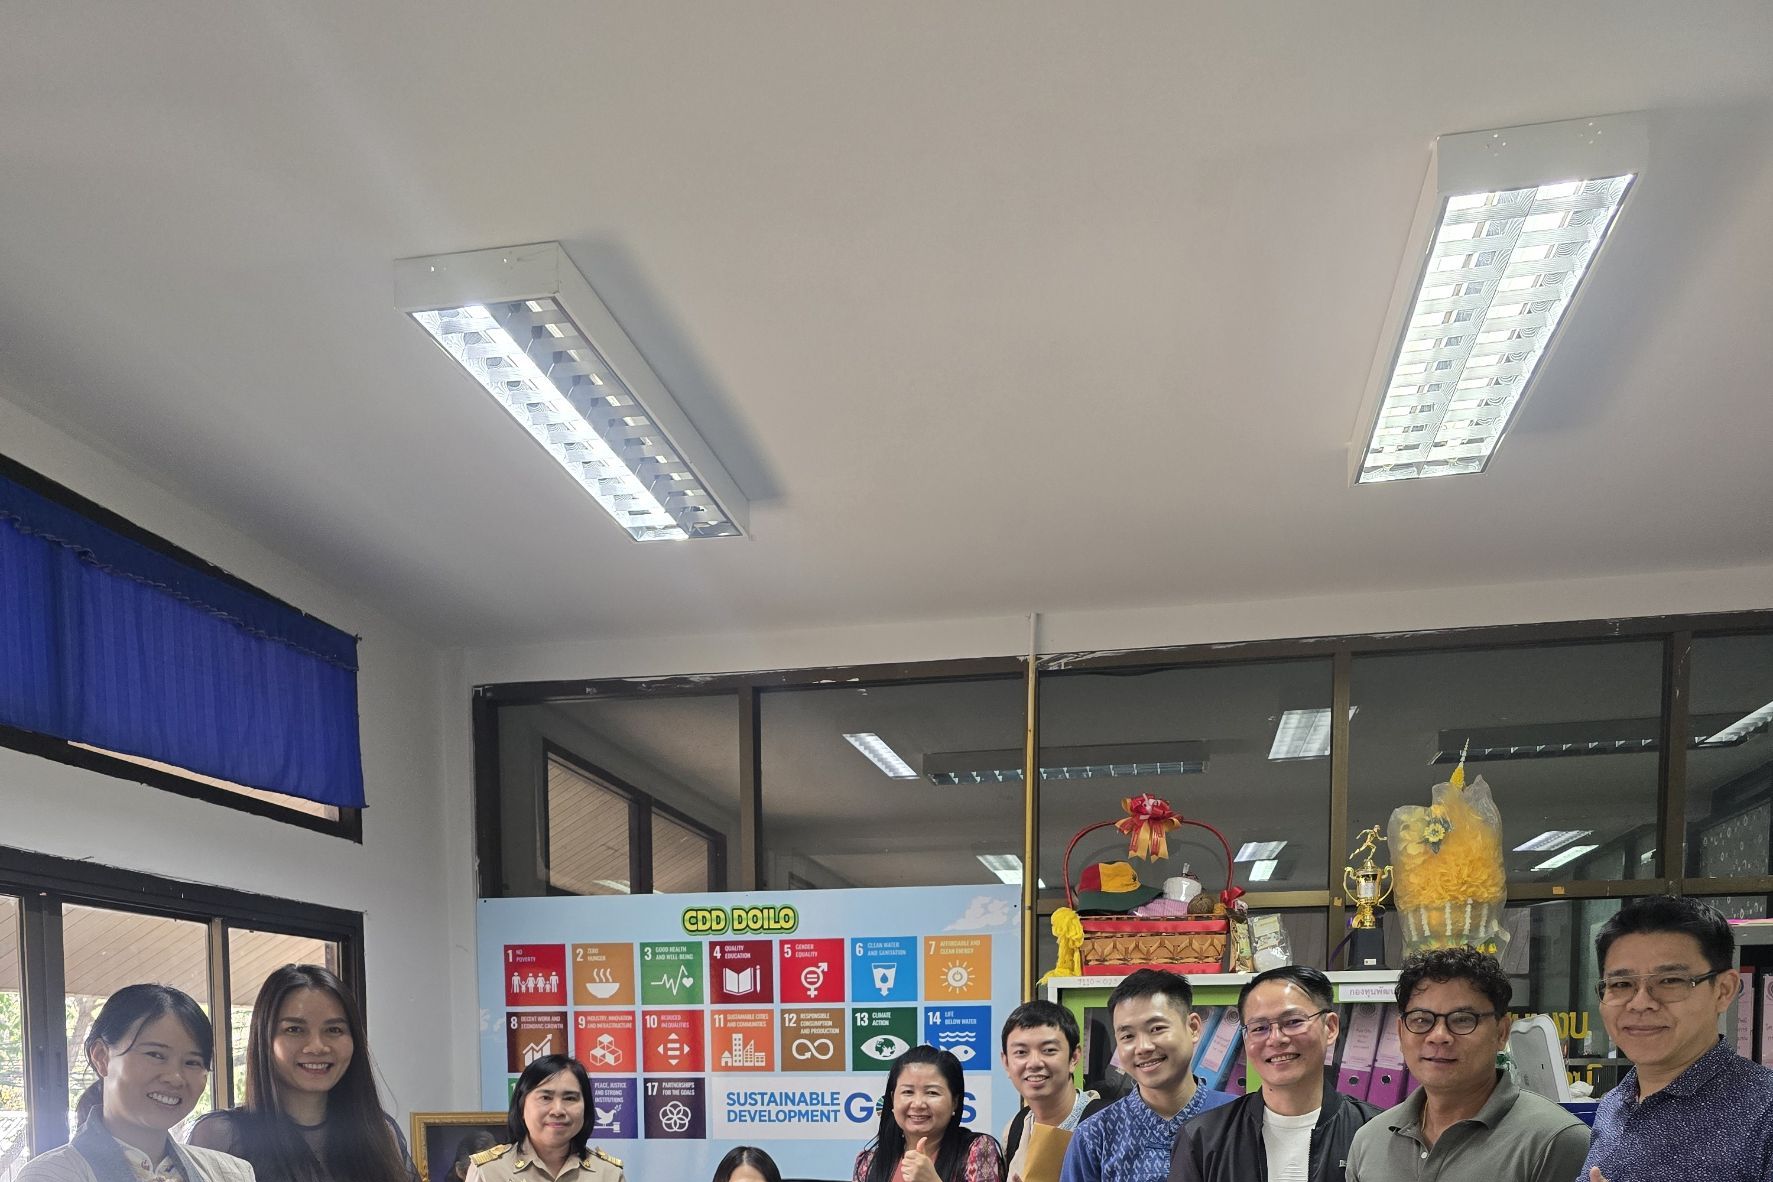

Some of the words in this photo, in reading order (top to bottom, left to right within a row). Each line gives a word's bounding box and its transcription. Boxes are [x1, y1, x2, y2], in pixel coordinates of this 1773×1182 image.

[682, 908, 728, 932] CDD
[731, 906, 796, 931] DOILO
[576, 948, 584, 962] 2
[644, 947, 652, 961] 3
[713, 945, 722, 959] 4
[784, 944, 792, 958] 5
[855, 942, 864, 957] 6
[928, 941, 936, 955] 7
[507, 950, 513, 962] 1
[510, 1016, 518, 1029] 8
[578, 1016, 586, 1029] 9
[645, 1015, 658, 1028] 10
[714, 1014, 724, 1027] 11
[784, 1013, 797, 1027] 12
[855, 1012, 869, 1026] 13
[928, 1011, 942, 1025] 14
[646, 1082, 659, 1096] 17
[726, 1091, 841, 1107] SUSTAINABLE
[727, 1109, 841, 1123] DEVELOPMENT
